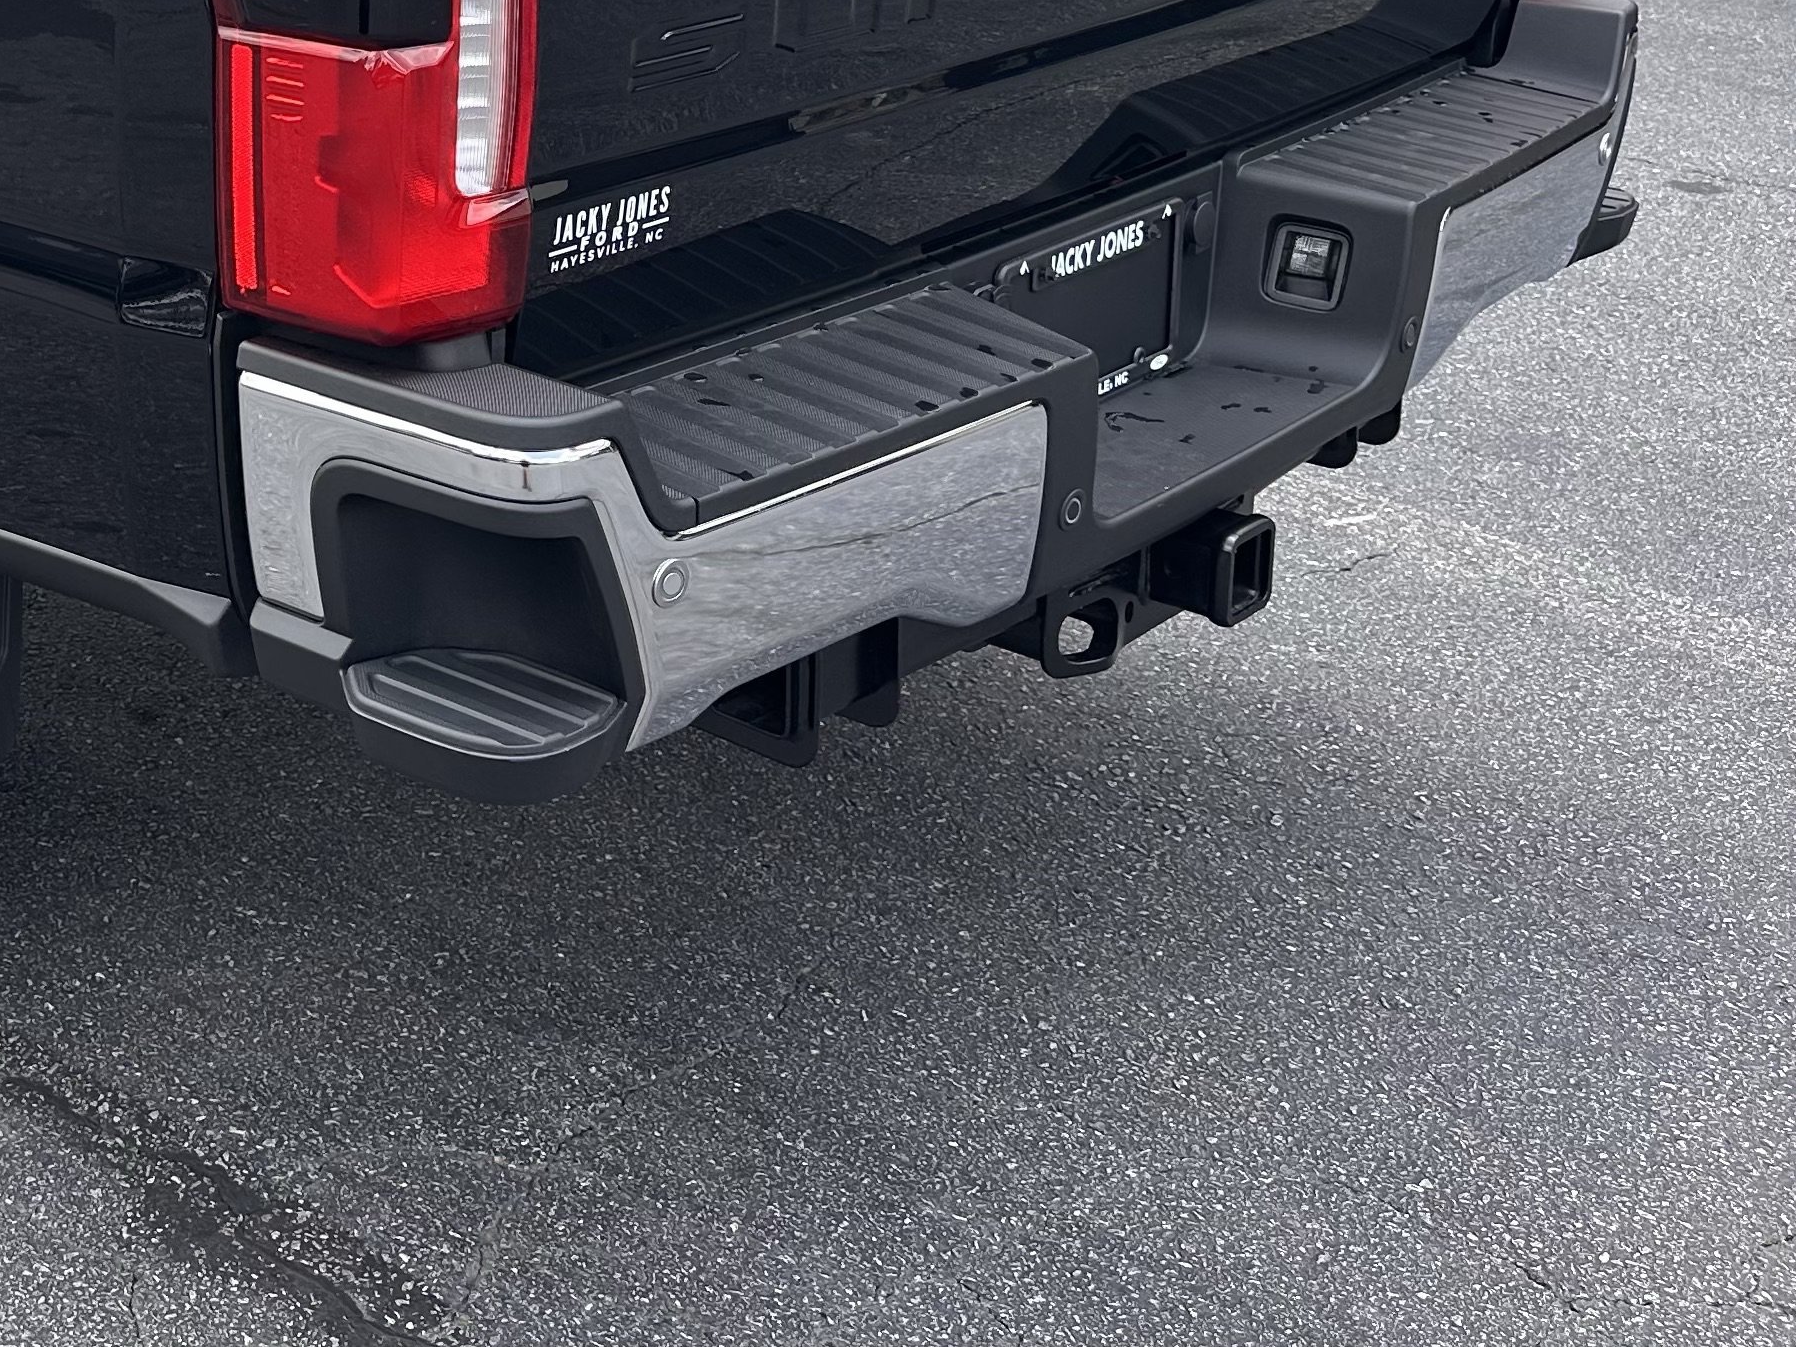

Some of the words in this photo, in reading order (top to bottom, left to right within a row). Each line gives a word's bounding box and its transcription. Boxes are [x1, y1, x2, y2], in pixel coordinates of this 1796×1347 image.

[553, 202, 612, 246] JACKY
[616, 185, 672, 227] JONES
[579, 221, 639, 252] FORD
[550, 237, 639, 274] HAYESVILLE,
[645, 228, 664, 244] NC
[1097, 220, 1145, 263] JONES
